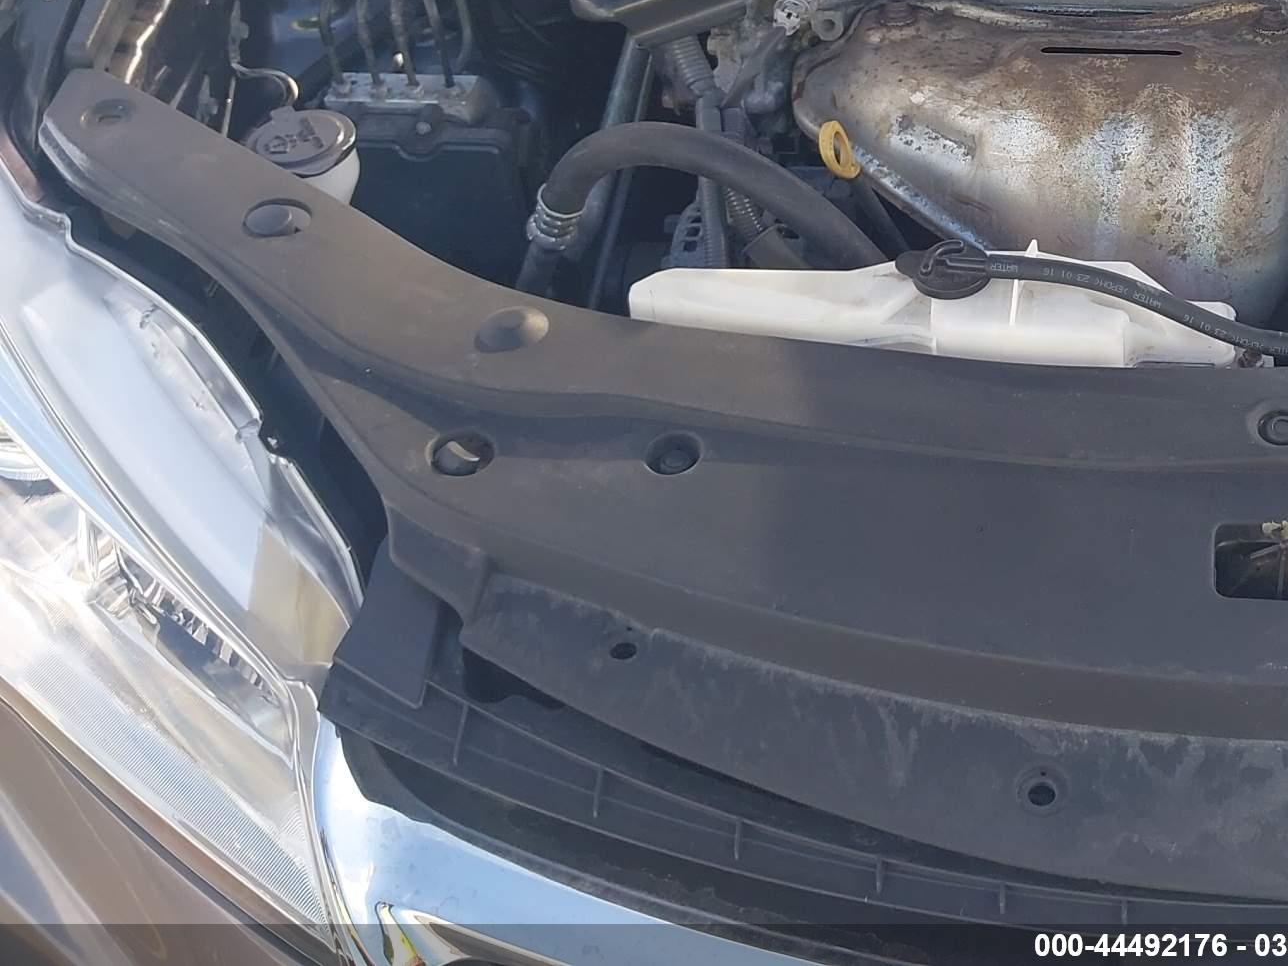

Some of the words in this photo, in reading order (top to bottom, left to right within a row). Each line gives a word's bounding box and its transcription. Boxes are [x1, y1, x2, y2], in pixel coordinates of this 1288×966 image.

[990, 262, 1018, 273] WATER
[1042, 267, 1055, 276] 16
[1061, 269, 1073, 279] 01
[1076, 273, 1090, 283] 23
[1132, 290, 1162, 309] WATER
